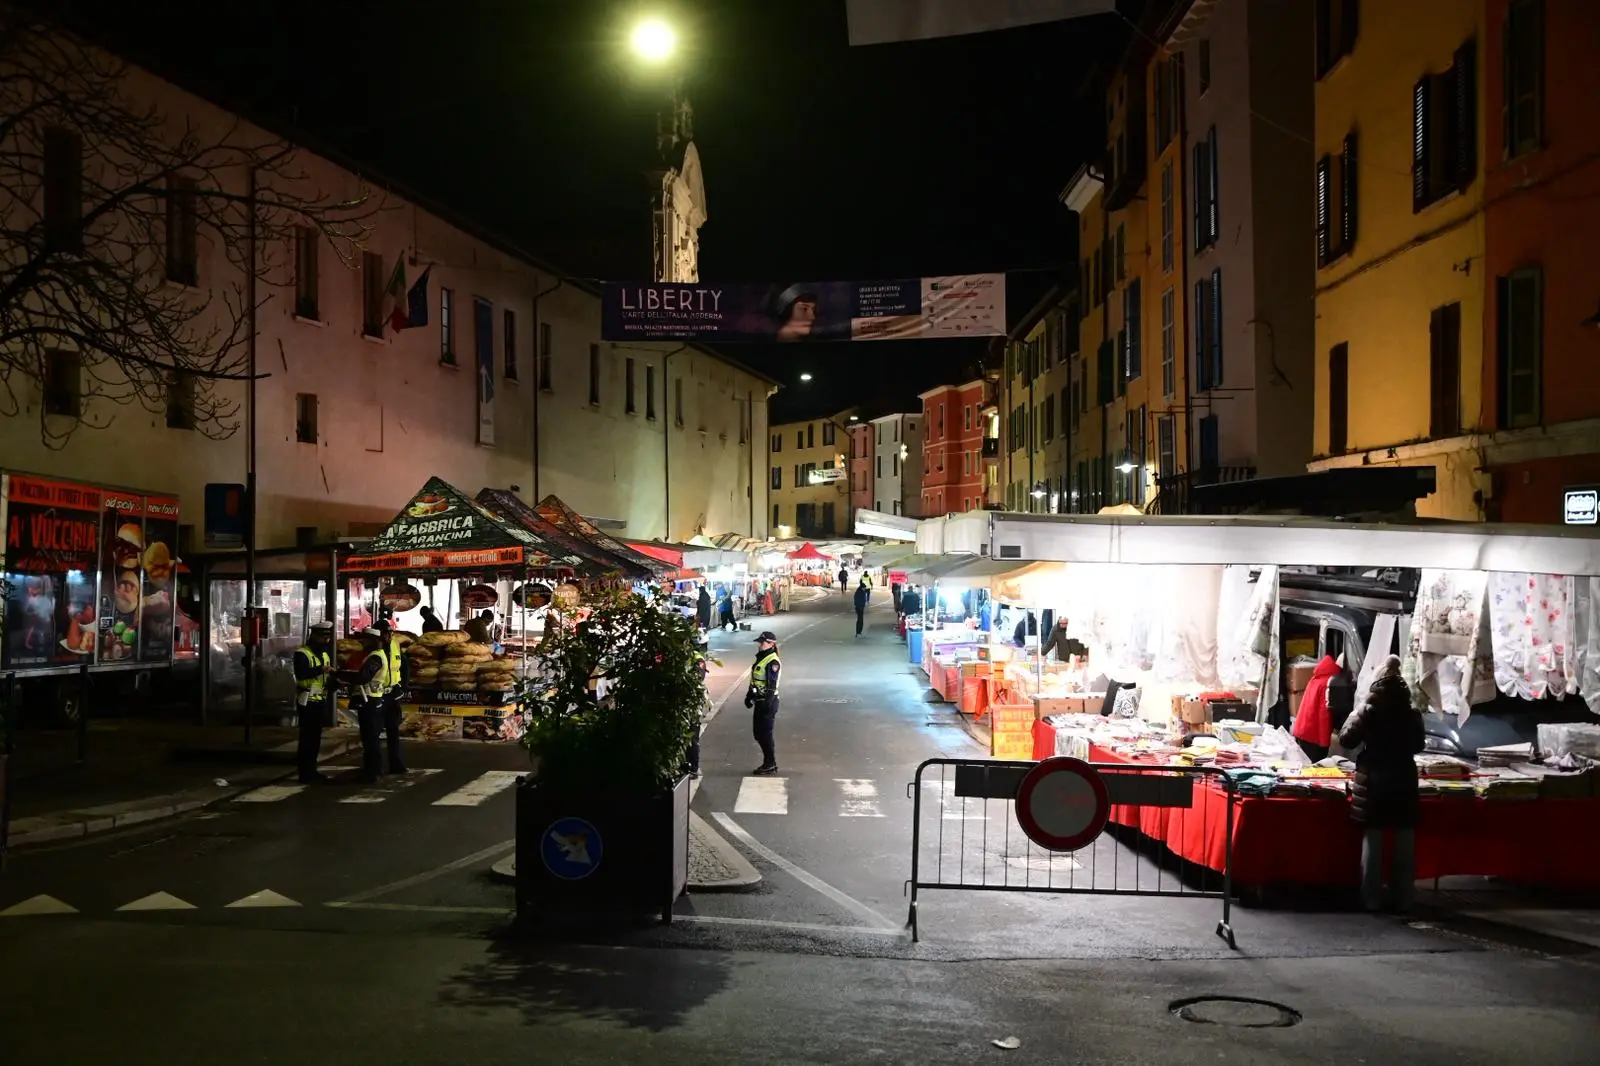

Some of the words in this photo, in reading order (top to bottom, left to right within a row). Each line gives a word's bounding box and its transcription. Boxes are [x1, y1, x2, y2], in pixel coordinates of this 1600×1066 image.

[621, 287, 723, 312] LIBERTY
[30, 512, 96, 552] VUCCIRIA
[398, 515, 474, 537] FABBRICA
[406, 529, 472, 544] ARANCINA
